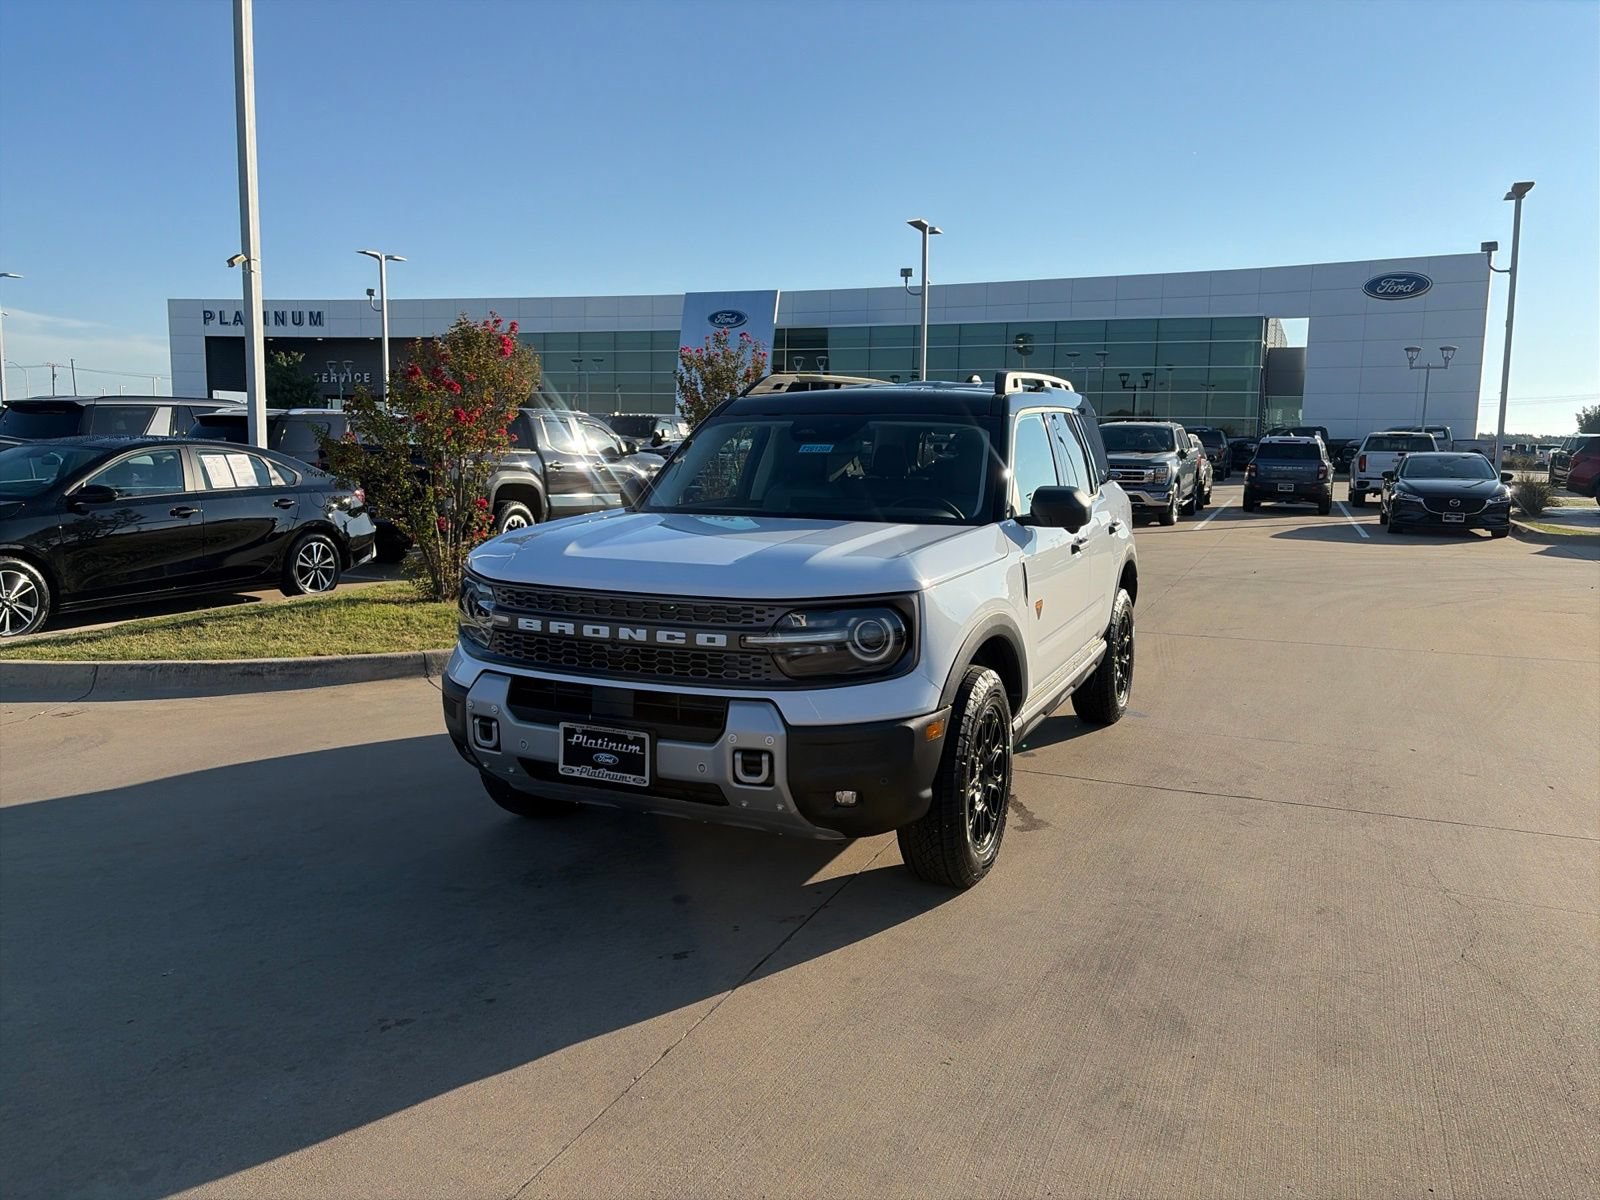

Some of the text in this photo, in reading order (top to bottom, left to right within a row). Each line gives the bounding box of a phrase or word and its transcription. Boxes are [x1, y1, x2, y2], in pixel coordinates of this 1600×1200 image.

[1376, 278, 1416, 293] Ford
[203, 310, 324, 327] PLAINUM
[714, 312, 737, 323] Ford
[517, 617, 727, 647] BRONCO
[567, 734, 645, 755] Platinum
